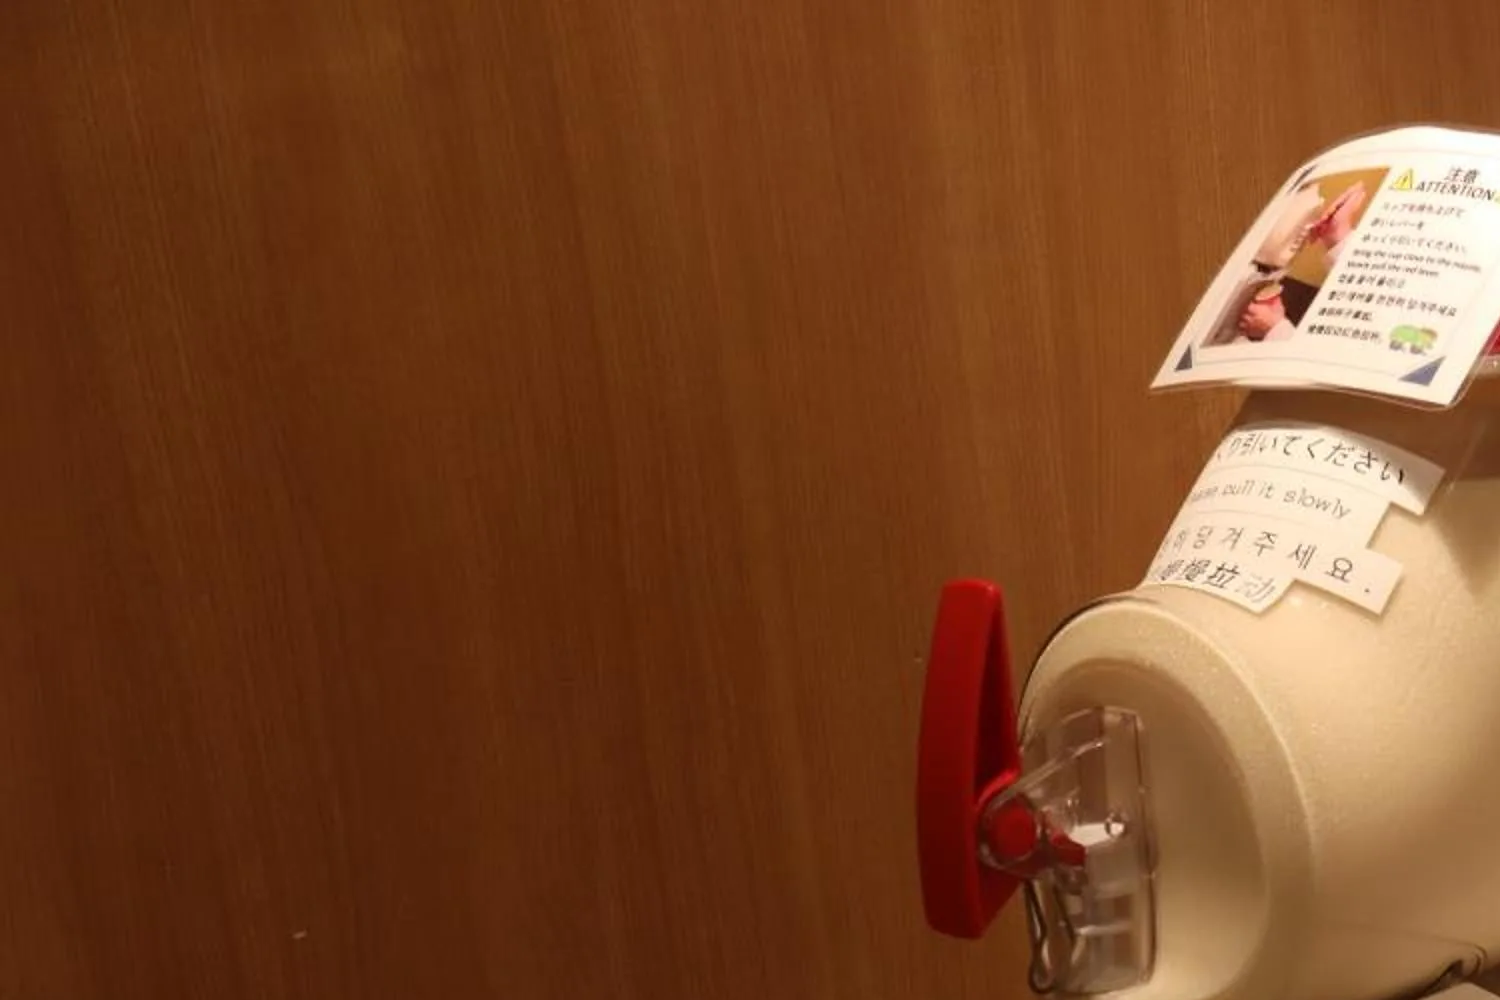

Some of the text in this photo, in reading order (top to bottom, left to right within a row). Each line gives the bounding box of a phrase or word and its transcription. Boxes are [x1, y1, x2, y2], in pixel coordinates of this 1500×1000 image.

[1415, 180, 1495, 201] ATTENTION
[1258, 481, 1276, 499] it
[1283, 487, 1352, 519] slowly
